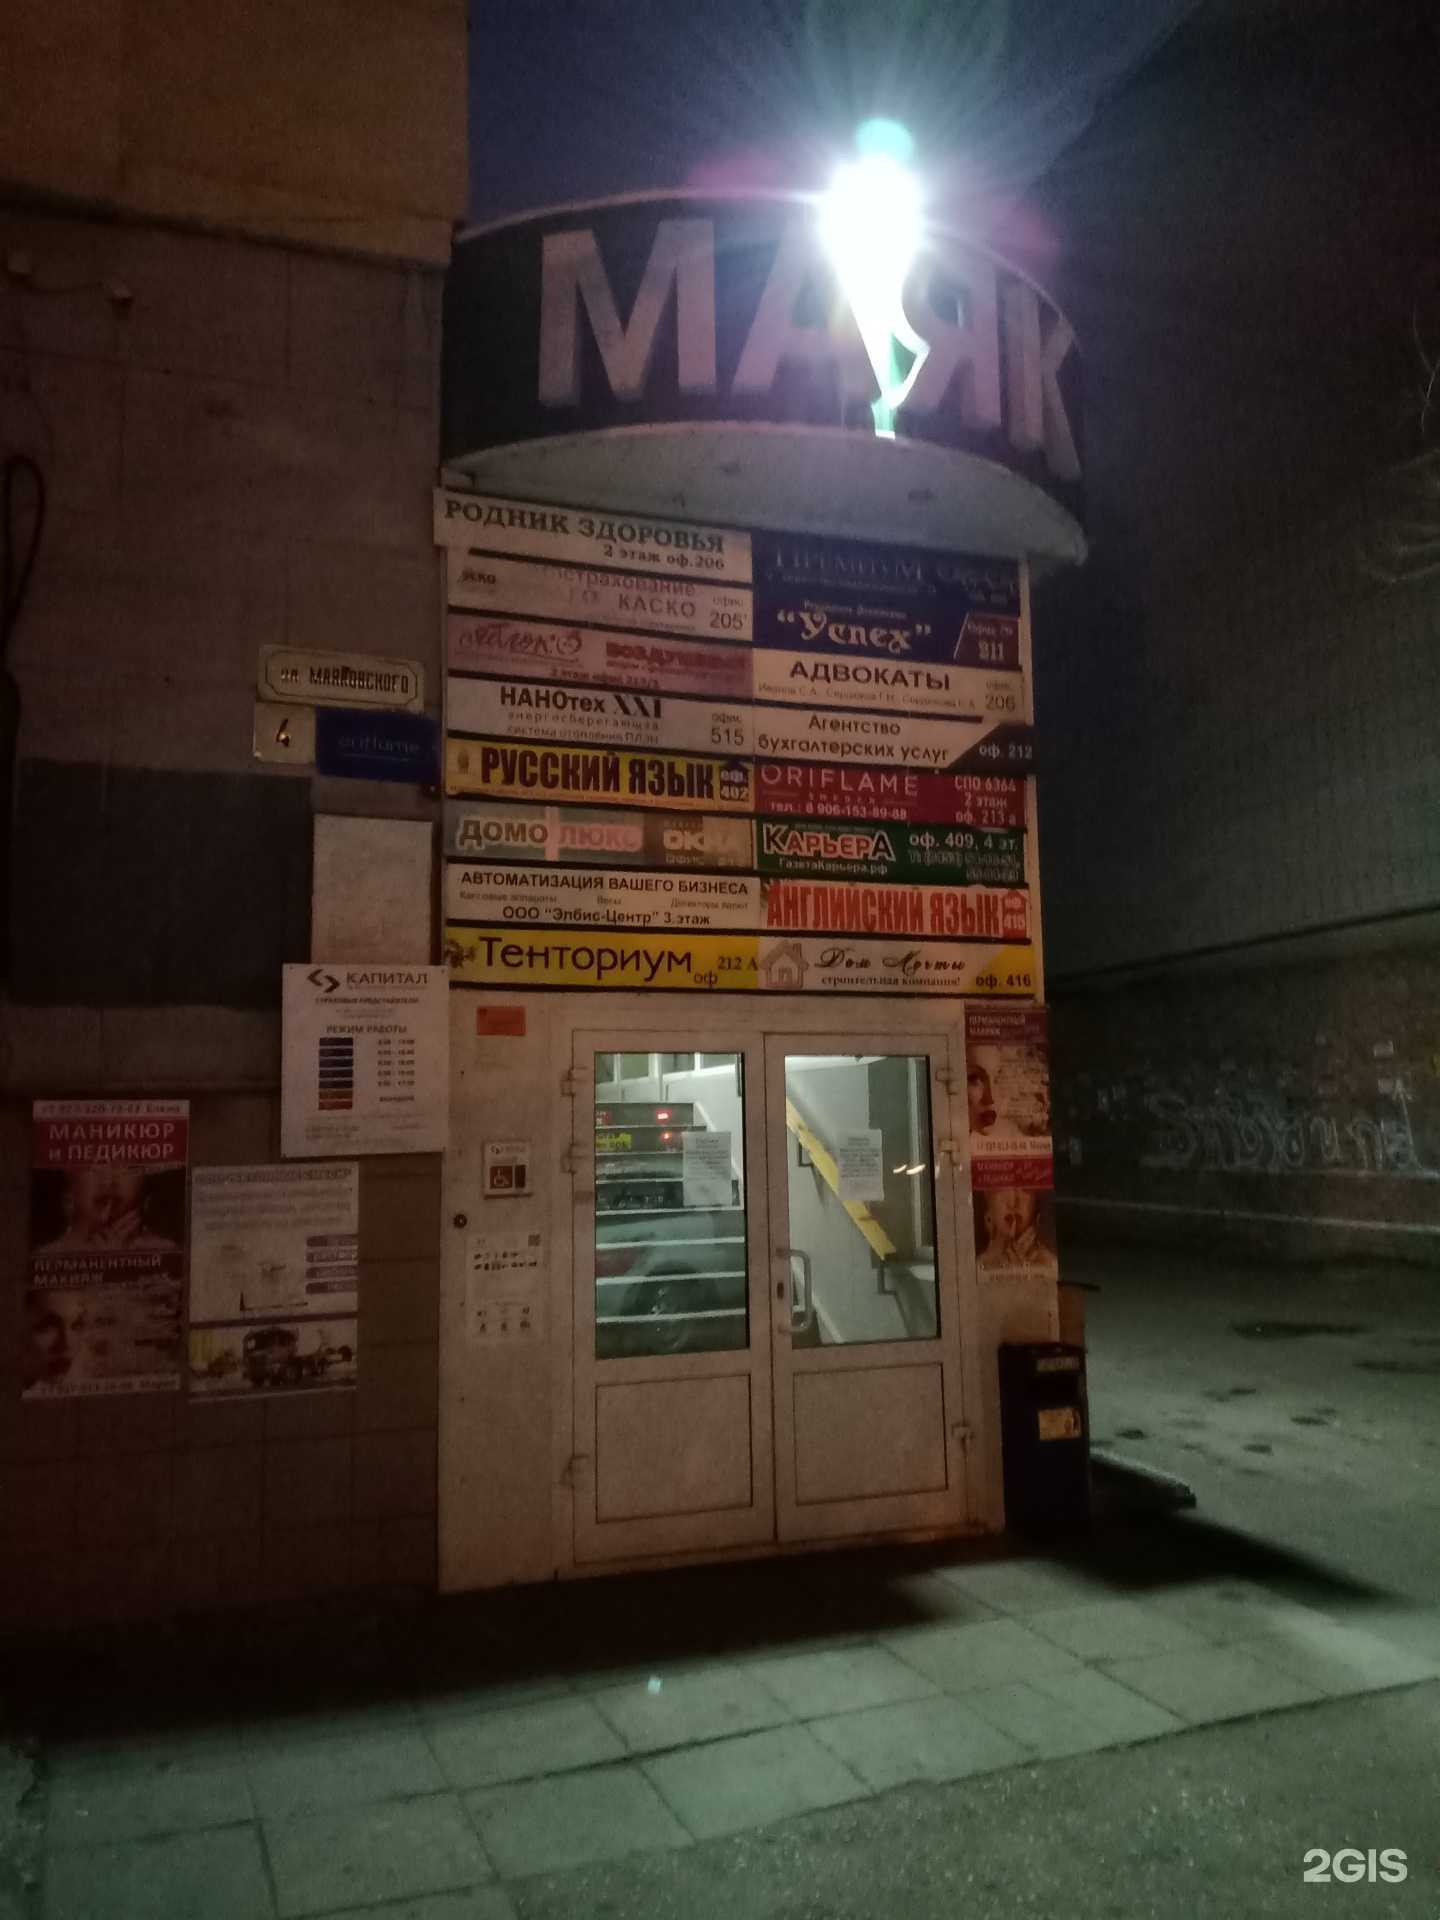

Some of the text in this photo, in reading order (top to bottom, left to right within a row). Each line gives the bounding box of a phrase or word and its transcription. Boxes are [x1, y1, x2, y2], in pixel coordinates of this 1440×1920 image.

[445, 500, 723, 553] РОДНИК ЗДОРОВЬЯ
[603, 545, 724, 569] 2 этаж оф.206
[619, 596, 696, 618] КАСКО
[710, 611, 743, 629] 205
[790, 661, 950, 690] АДВОКАТЫ
[500, 685, 605, 713] НАНОтех
[809, 716, 900, 736] Агентство
[711, 728, 744, 745] 515
[759, 735, 948, 760] бухгалтерских услуг
[1008, 744, 1032, 758] 212
[481, 747, 714, 800] РУССКИЙ ЯЗЫК
[760, 764, 920, 796] ORIFLAME
[944, 834, 979, 850] 409,
[983, 834, 993, 847] 4
[461, 871, 748, 895] АВТОМАТИЗАЦИЯ ВАШЕГО БИЗНЕСА
[503, 905, 539, 919] ООО
[767, 884, 1000, 935] АНГЛИЙСКИЙ ЯЗЫК
[479, 936, 692, 982] Тенториум
[718, 955, 742, 970] 212
[346, 972, 428, 985] КАПИТАЛ
[976, 976, 1000, 990] оф.
[326, 1025, 364, 1033] РЕЖИМ
[49, 1123, 175, 1140] МАНИКЮР
[68, 1143, 174, 1162] ПЕДИКЮР
